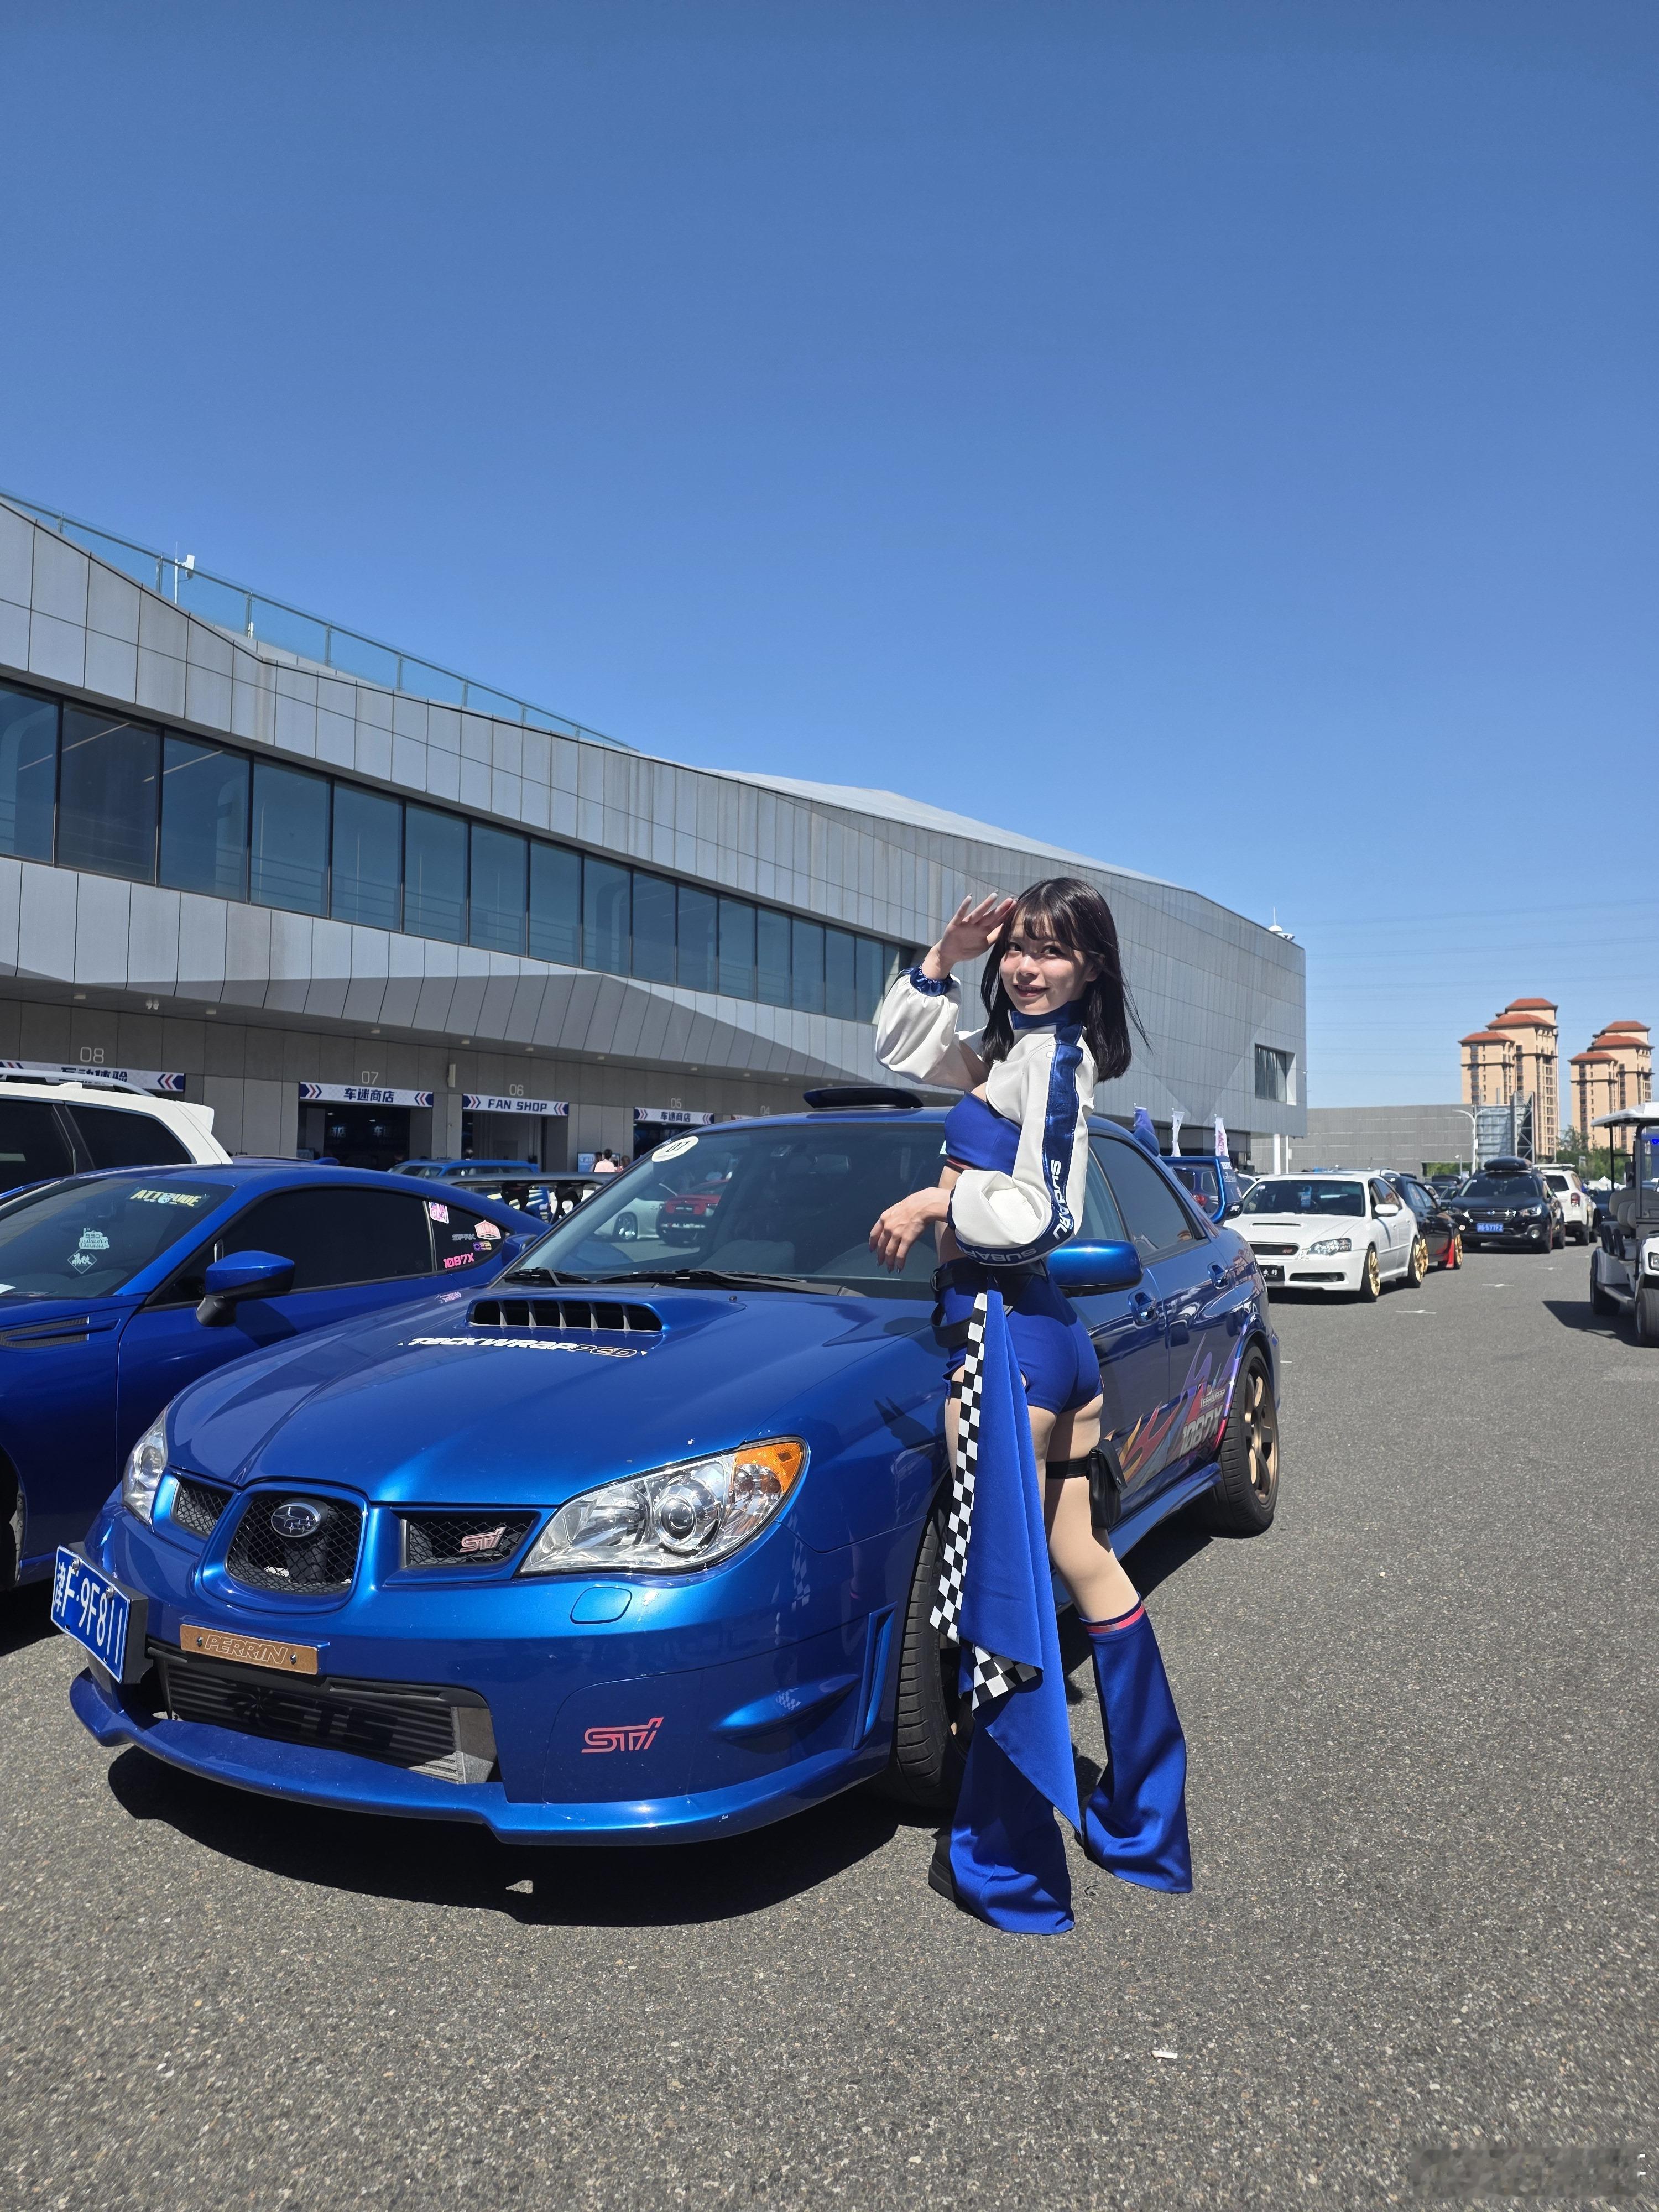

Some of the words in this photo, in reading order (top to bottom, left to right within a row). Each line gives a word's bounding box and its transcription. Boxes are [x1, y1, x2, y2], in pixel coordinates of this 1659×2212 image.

[80, 1047, 105, 1063] 08
[361, 1071, 379, 1084] 07
[343, 1088, 395, 1103] 车迷商店
[509, 1083, 524, 1096] 06
[488, 1099, 512, 1110] FAN
[516, 1101, 547, 1112] SHOP
[670, 1097, 682, 1109] 05
[760, 1105, 770, 1115] 04
[660, 1111, 691, 1123] 车迷商店
[204, 1634, 288, 1665] PERRIN
